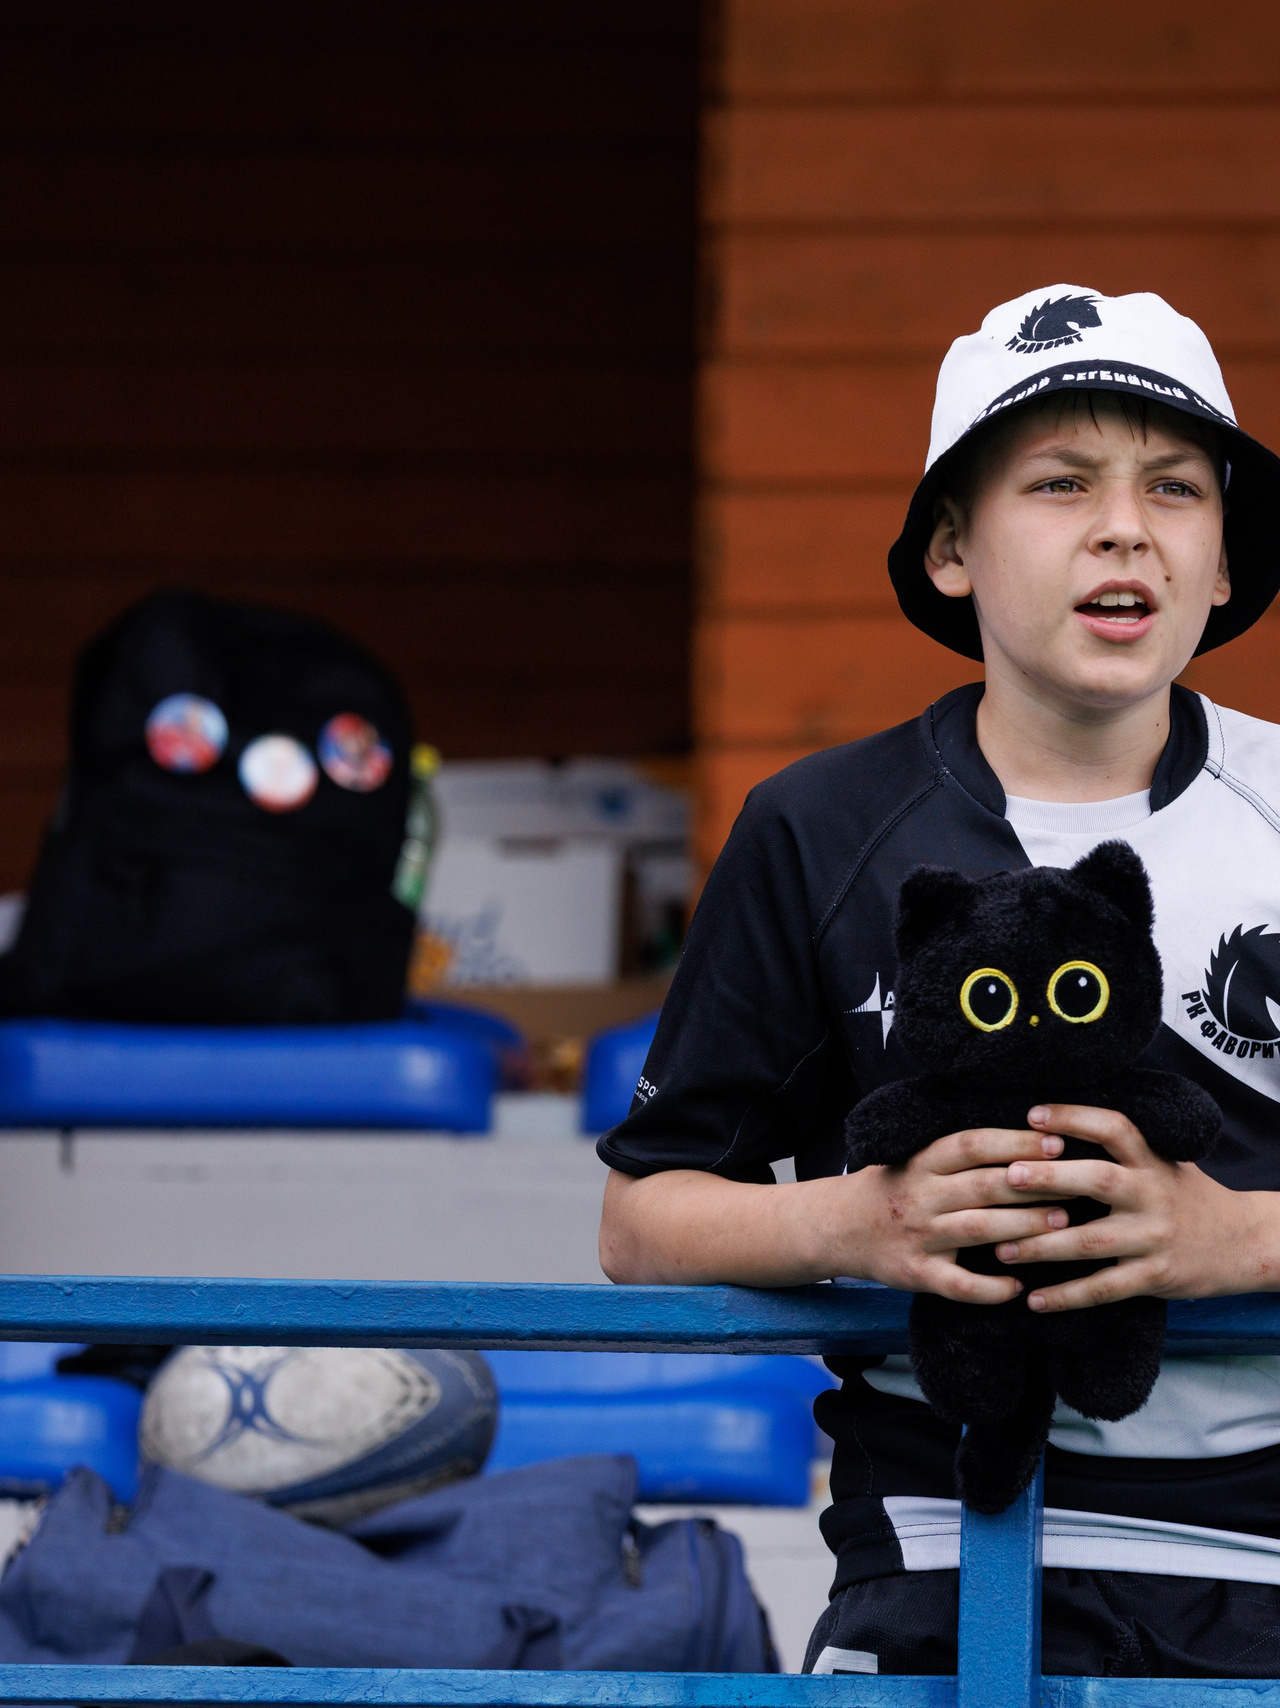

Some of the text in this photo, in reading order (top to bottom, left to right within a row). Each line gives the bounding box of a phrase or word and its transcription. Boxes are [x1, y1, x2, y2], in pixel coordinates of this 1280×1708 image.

[1061, 370, 1189, 400] РЕГБИЙНЫЙ
[1181, 990, 1207, 1020] РК
[637, 1076, 659, 1097] SPO
